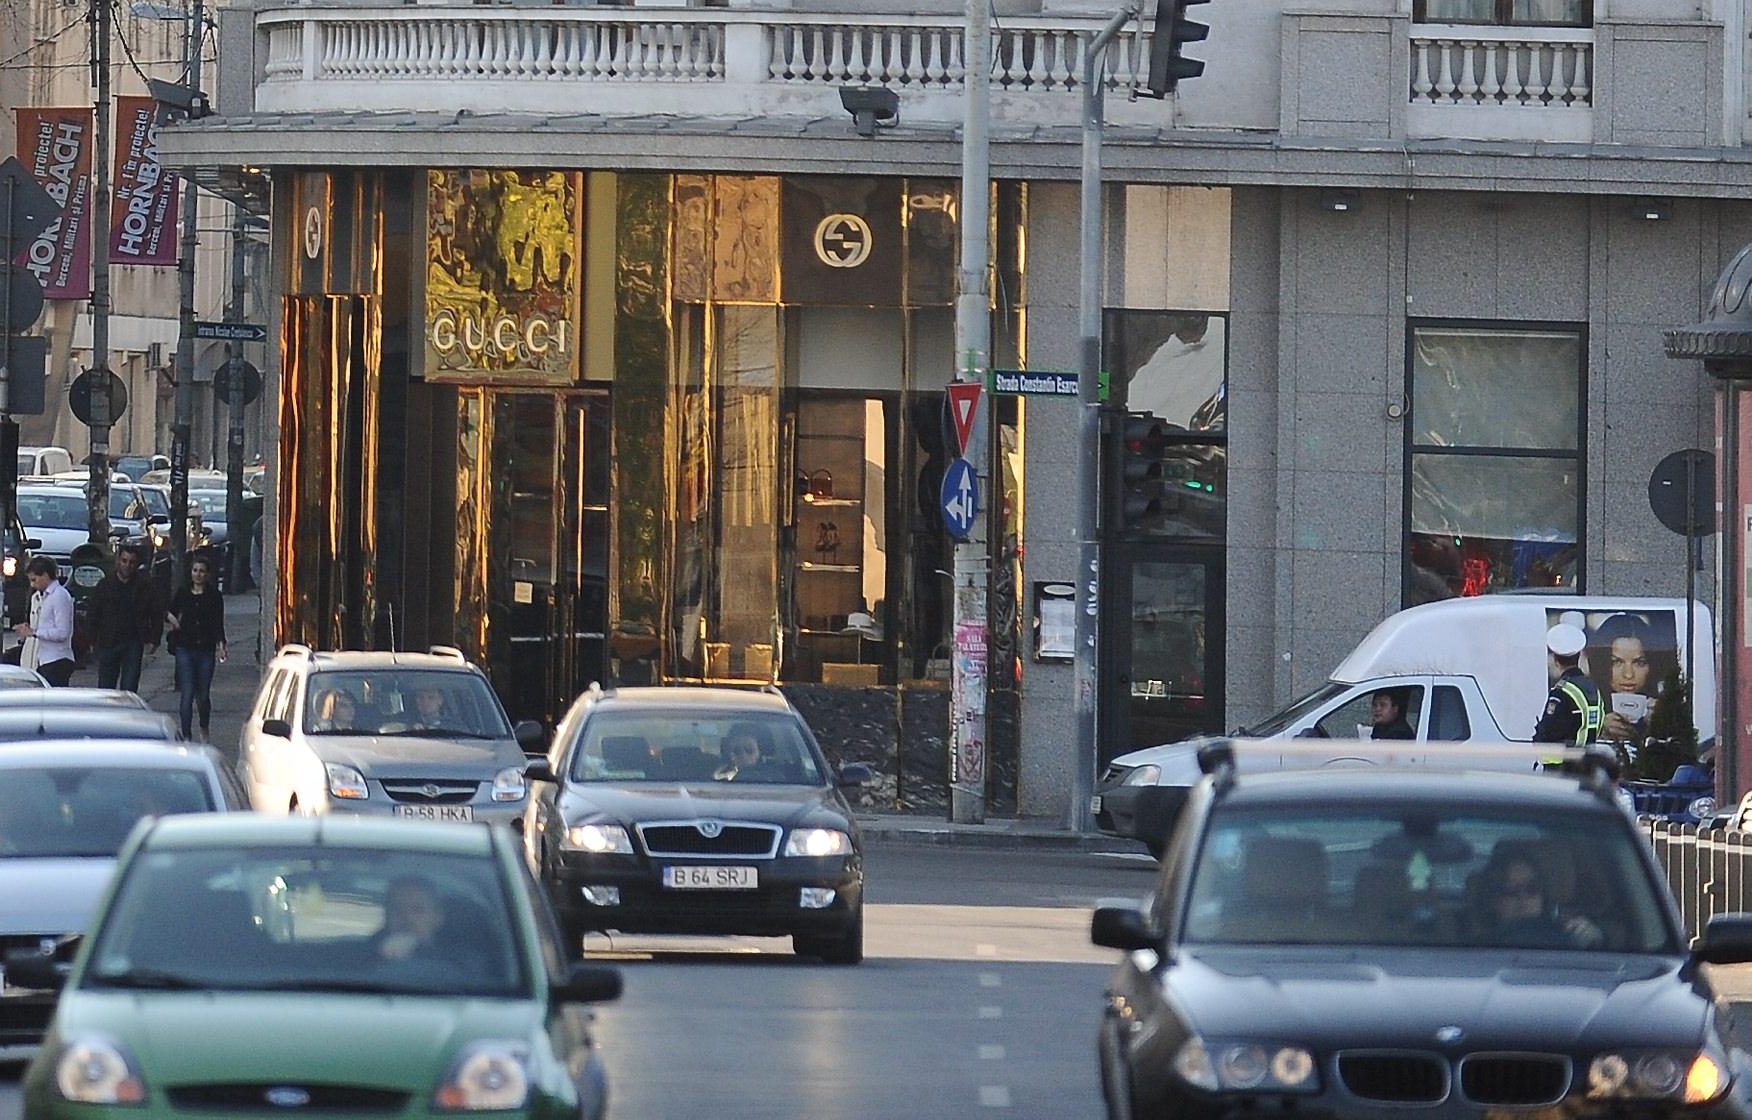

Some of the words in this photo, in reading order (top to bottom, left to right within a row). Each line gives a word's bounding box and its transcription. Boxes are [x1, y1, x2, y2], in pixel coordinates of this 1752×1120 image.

[26, 123, 82, 288] HORBACH
[434, 318, 565, 353] GUCCI
[996, 373, 1019, 391] Strada
[1020, 375, 1056, 392] Constantin
[418, 807, 434, 819] 58
[441, 807, 467, 821] HKA
[675, 869, 685, 885] B
[691, 870, 710, 885] 64
[716, 869, 748, 885] SRJ
